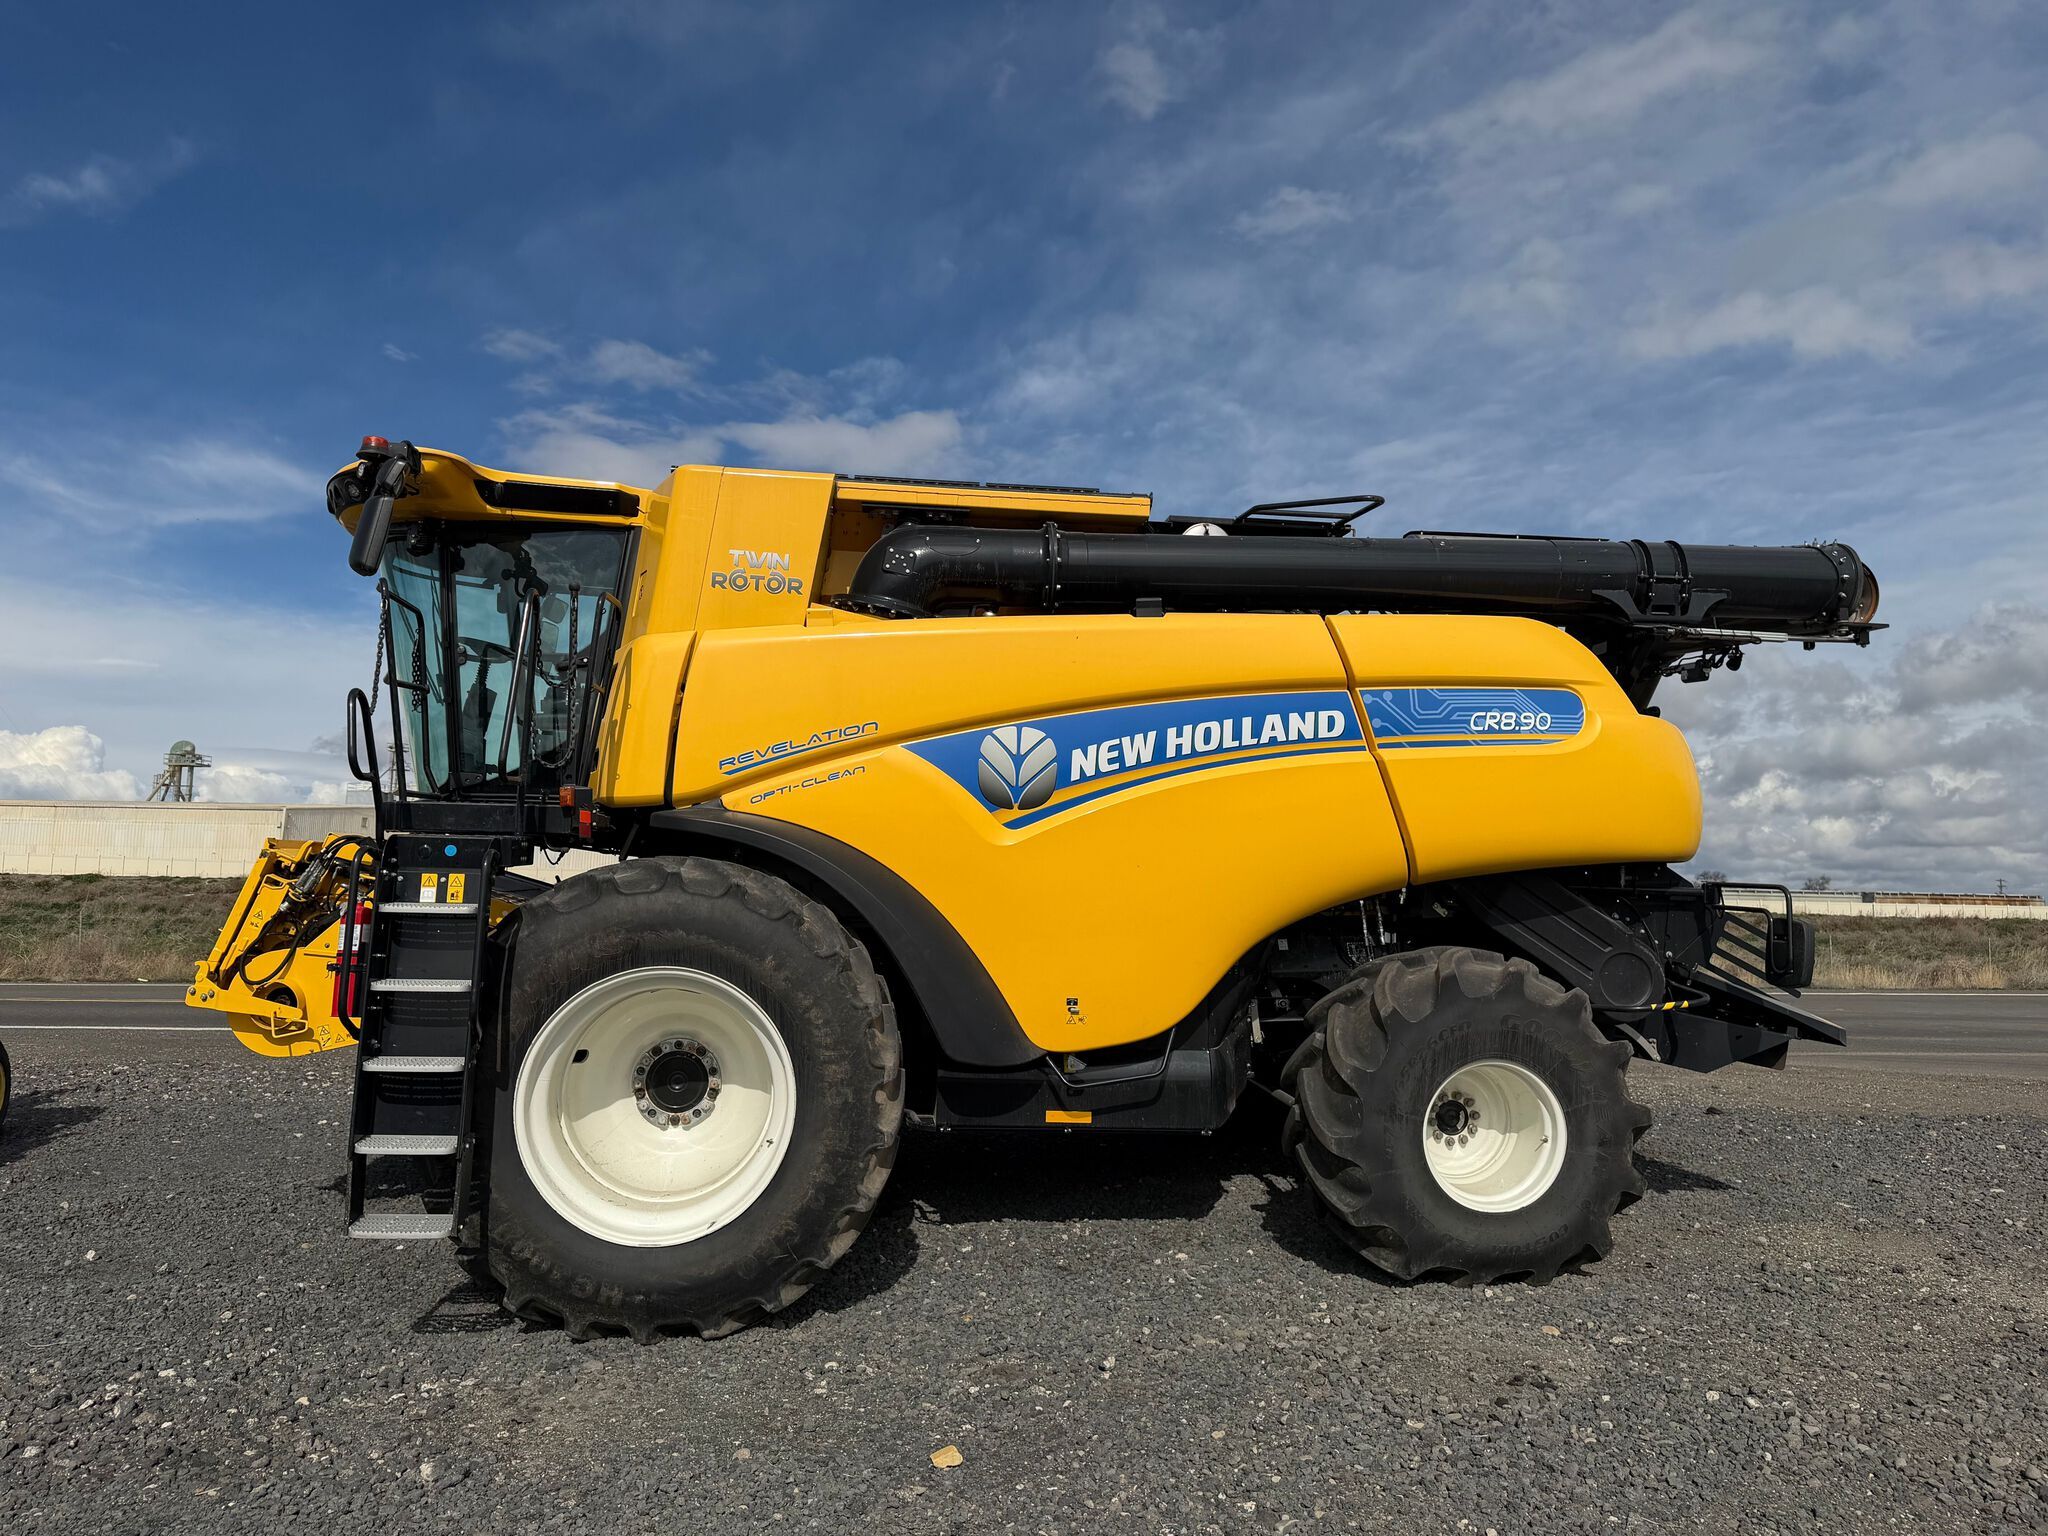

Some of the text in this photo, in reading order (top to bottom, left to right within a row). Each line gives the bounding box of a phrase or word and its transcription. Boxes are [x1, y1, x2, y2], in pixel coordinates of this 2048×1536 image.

[729, 549, 790, 571] TWIN
[711, 568, 804, 596] ROTOR
[1470, 711, 1552, 731] CR8.90
[718, 721, 879, 770] REVELATION
[1070, 709, 1346, 782] NEW HOLLAND
[750, 765, 866, 805] OPTI-CLEAN
